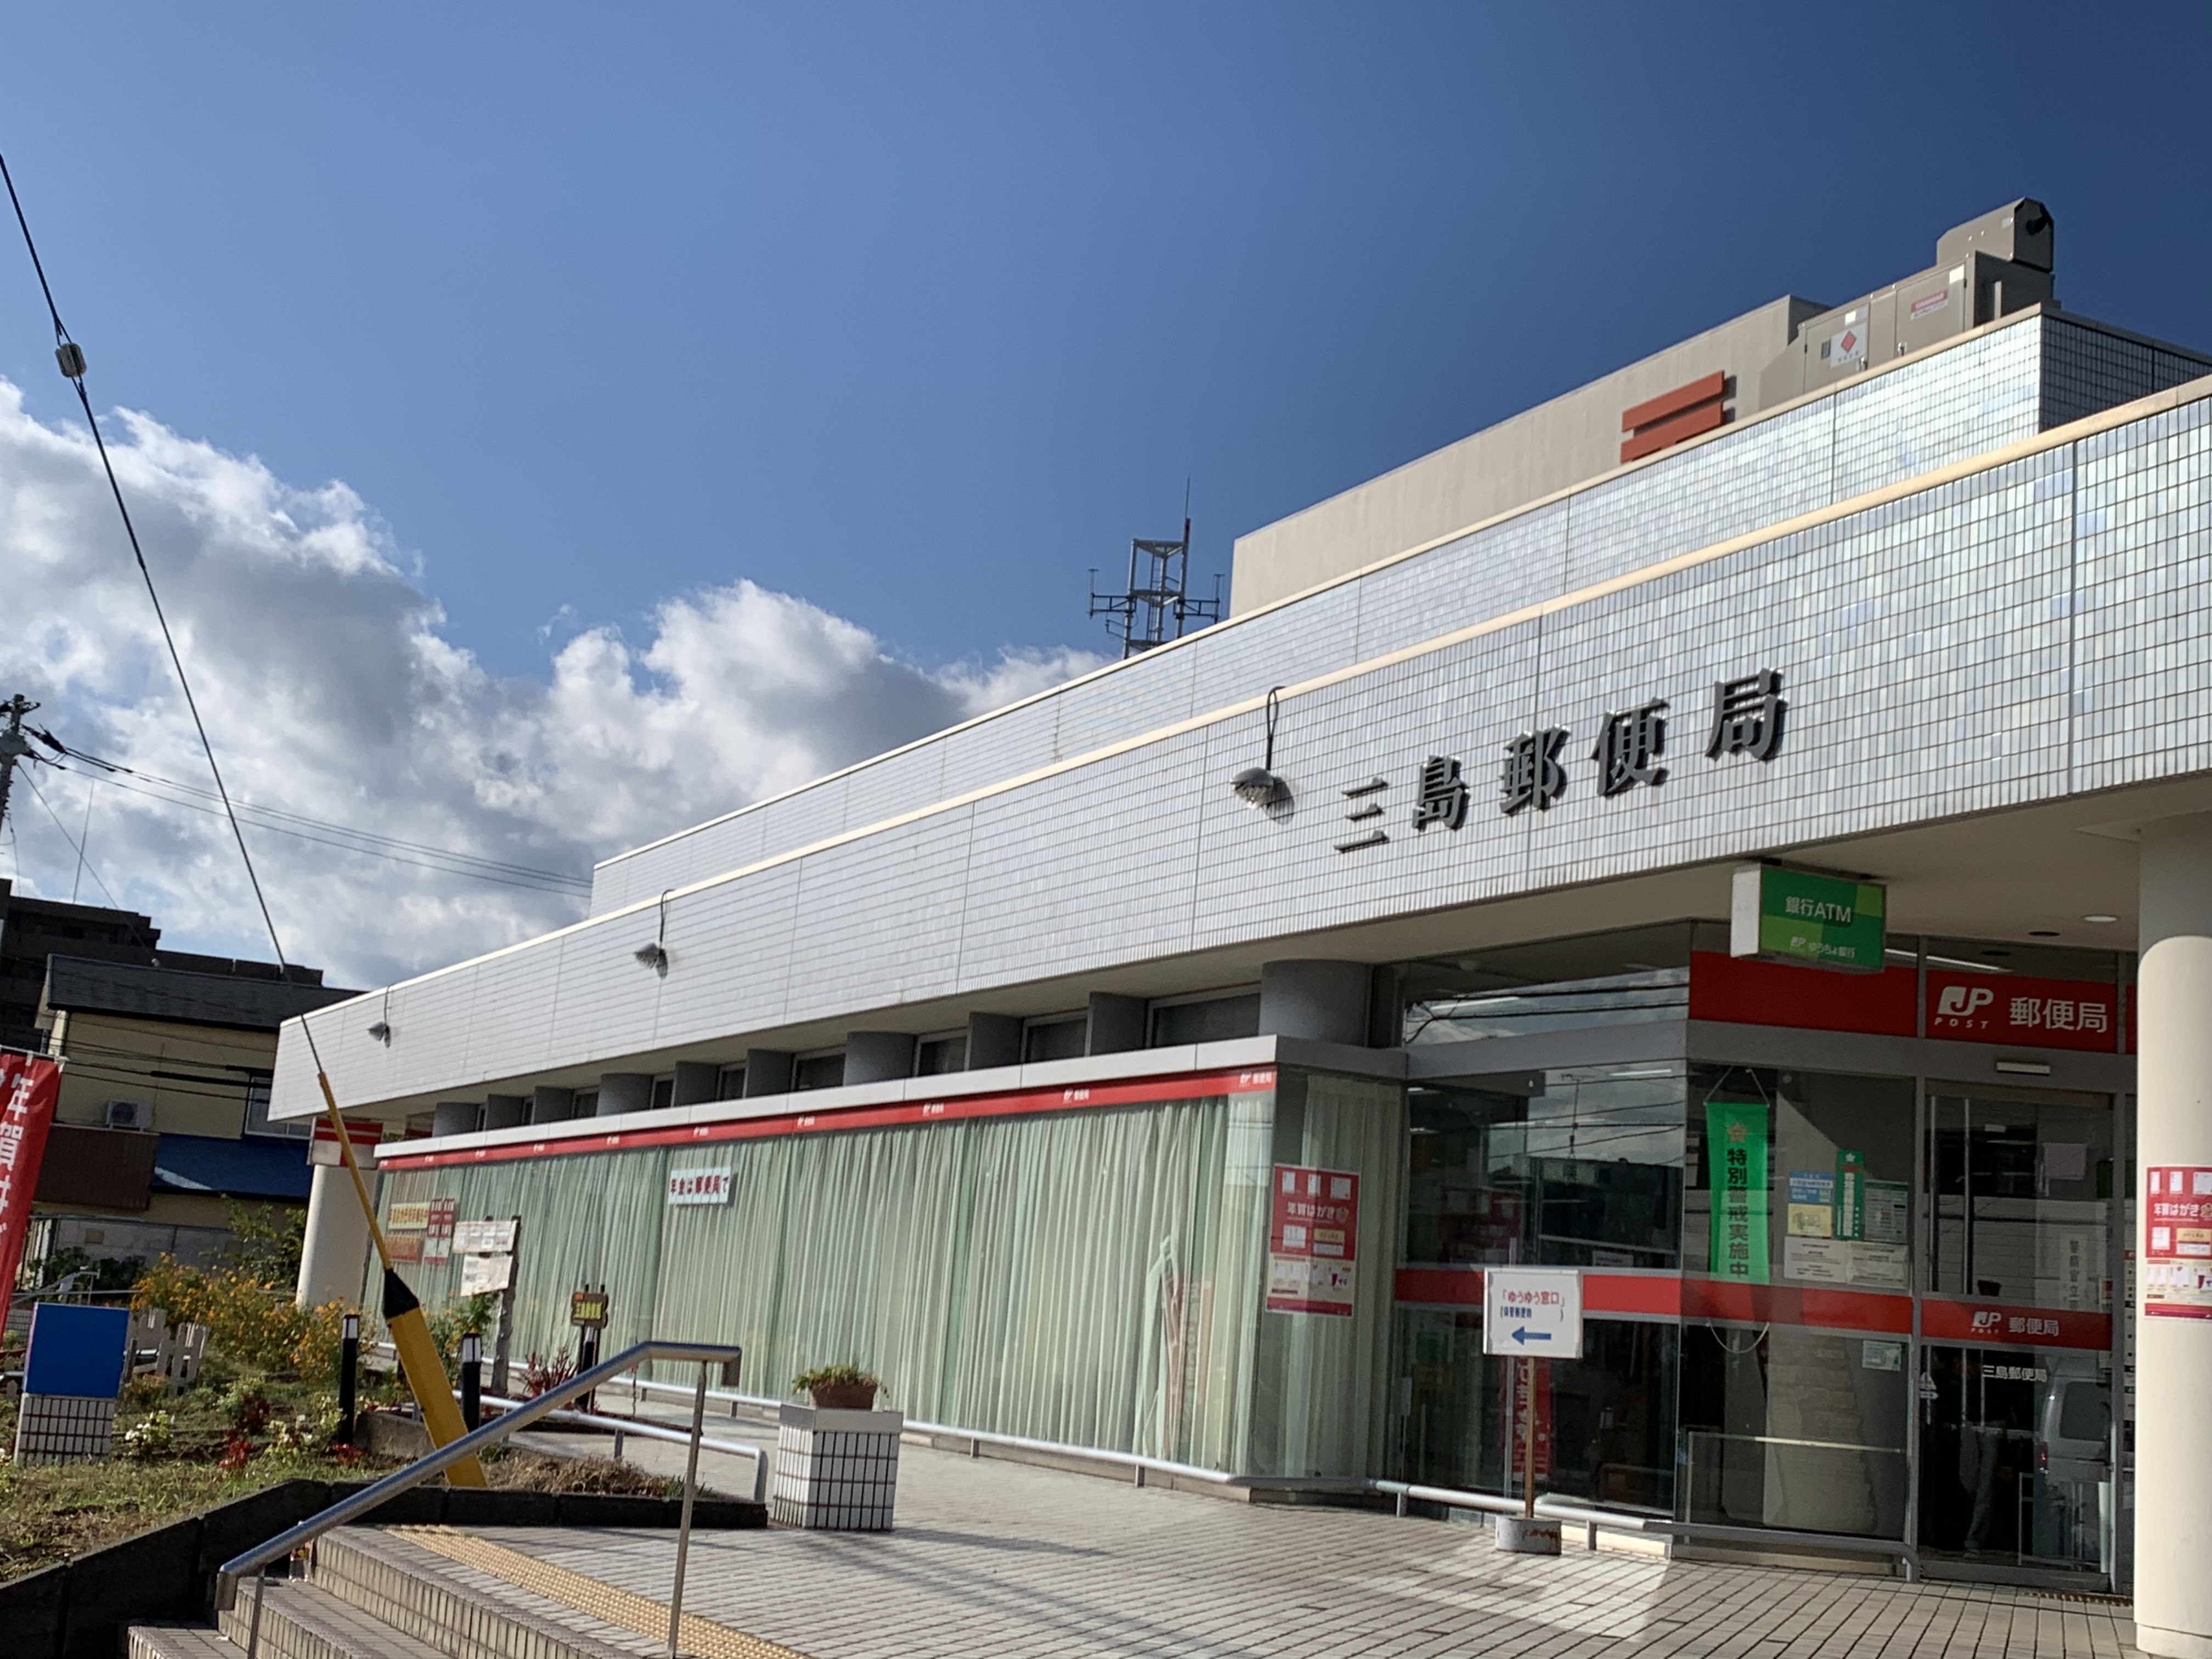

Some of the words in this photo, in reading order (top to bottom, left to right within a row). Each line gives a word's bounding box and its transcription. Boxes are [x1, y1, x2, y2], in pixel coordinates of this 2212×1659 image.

[1334, 667, 1787, 854] 三島郵便局
[1786, 896, 1852, 923] 銀行ATM
[1934, 1017, 1989, 1029] POST
[2010, 997, 2108, 1033] 郵便局
[1727, 1148, 1749, 1279] 特別警戒実施中
[2008, 1317, 2059, 1336] 郵便局
[1982, 1365, 2047, 1383] 三島郵便局
